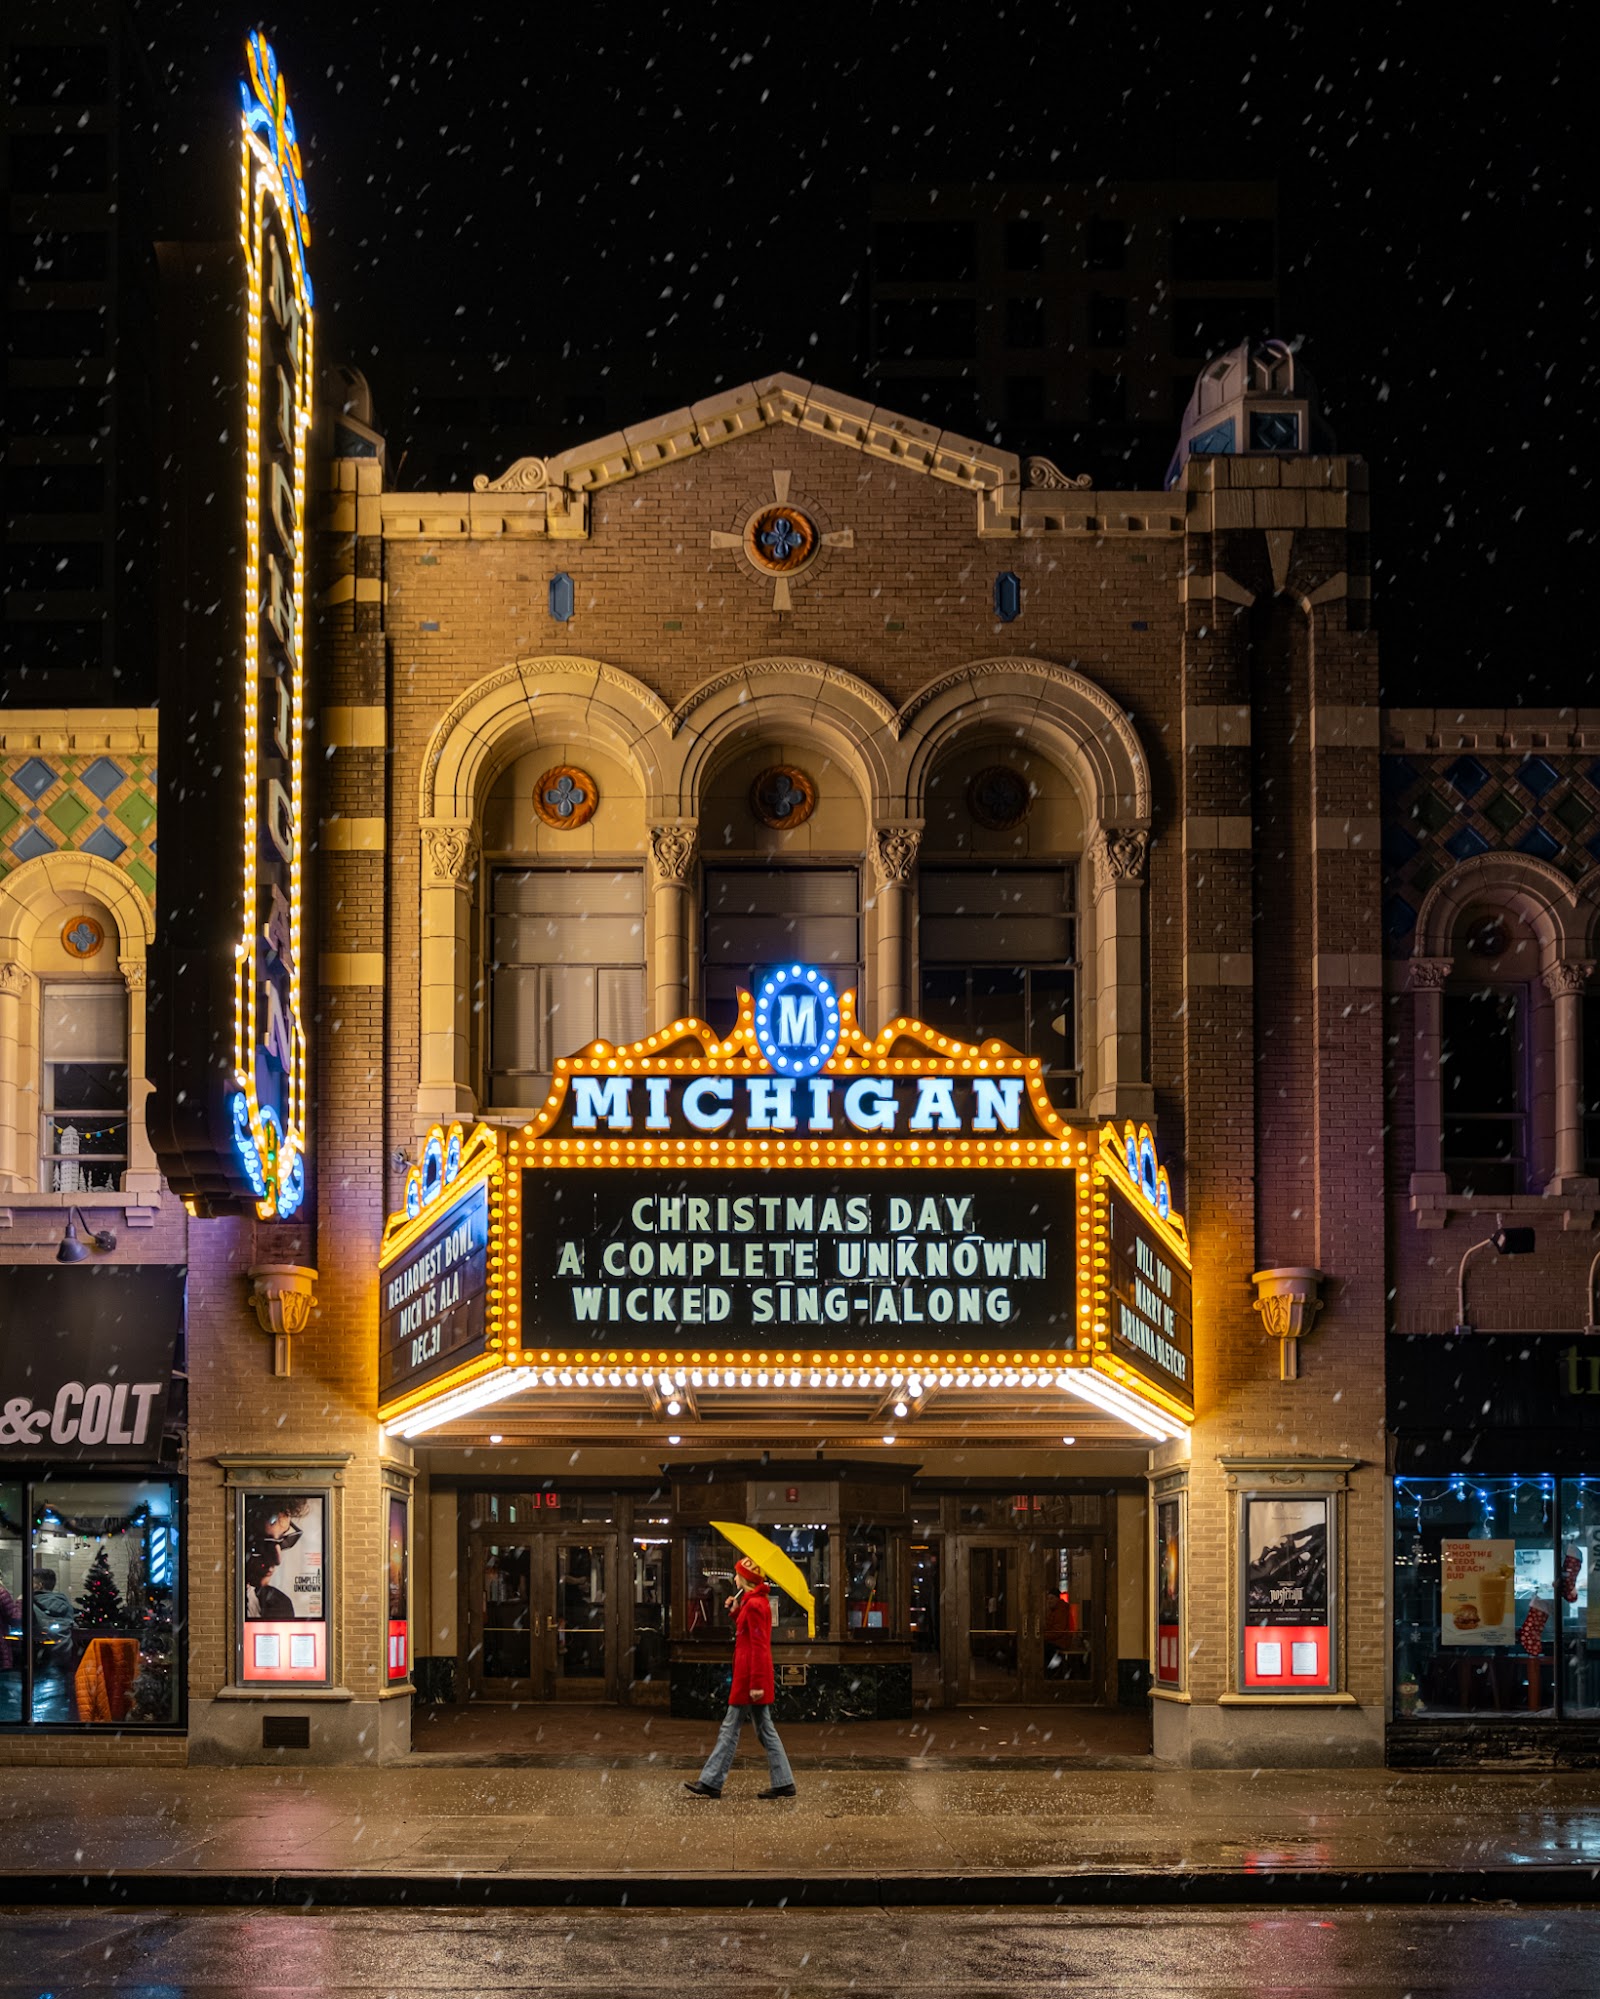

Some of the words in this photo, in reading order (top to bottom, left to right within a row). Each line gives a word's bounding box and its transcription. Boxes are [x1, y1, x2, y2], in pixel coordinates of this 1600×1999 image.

[264, 234, 301, 1074] MICHIGAN
[778, 995, 818, 1047] M
[572, 1077, 1024, 1132] MICHIGAN
[632, 1197, 868, 1231] CHRISTMAS
[890, 1197, 971, 1231] DAY
[388, 1243, 442, 1311] RELIAQUEST
[445, 1219, 474, 1268] BOWL
[557, 1242, 582, 1275] A
[603, 1241, 814, 1276] COMPLETE
[838, 1242, 1041, 1277] UNKNOWN
[1136, 1236, 1154, 1282] WILL
[1156, 1258, 1172, 1298] YOU
[400, 1298, 422, 1338] MICH
[424, 1285, 436, 1321] VS
[440, 1271, 460, 1312] ALA
[572, 1286, 730, 1322] WICKED
[752, 1286, 1011, 1322] SING-ALONG
[1135, 1276, 1162, 1326] MARRY
[1163, 1303, 1175, 1338] ME
